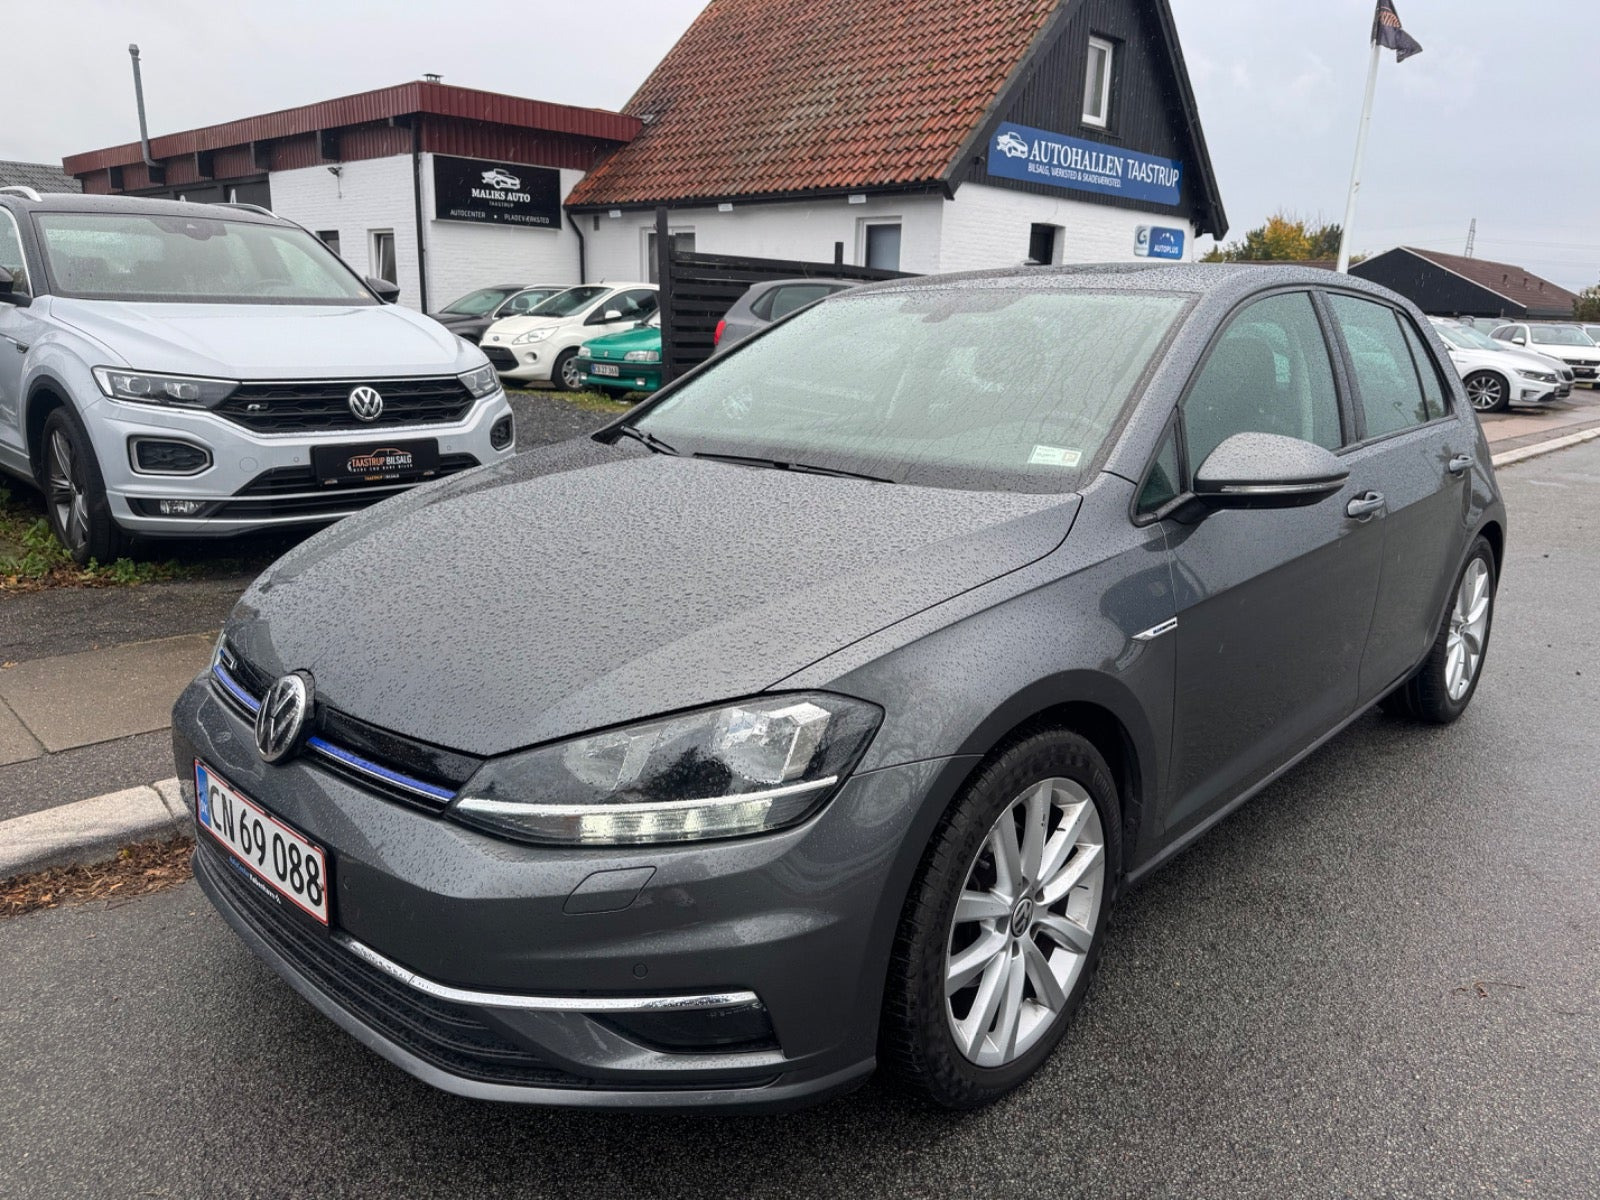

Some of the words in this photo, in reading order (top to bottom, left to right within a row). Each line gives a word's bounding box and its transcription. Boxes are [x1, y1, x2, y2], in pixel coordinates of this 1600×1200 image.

[1029, 139, 1124, 177] AUTOHALLEN
[1127, 159, 1180, 188] TAASTRUP
[471, 188, 506, 201] MALIKS
[507, 192, 531, 203] AUTO
[450, 209, 486, 218] AUTOCENTER
[1154, 244, 1179, 255] AUTOPLUS
[352, 456, 385, 467] TAASTRUP
[386, 454, 412, 465] BILSALG
[209, 784, 235, 843] CN
[239, 808, 267, 866] 69
[272, 832, 323, 907] 088
